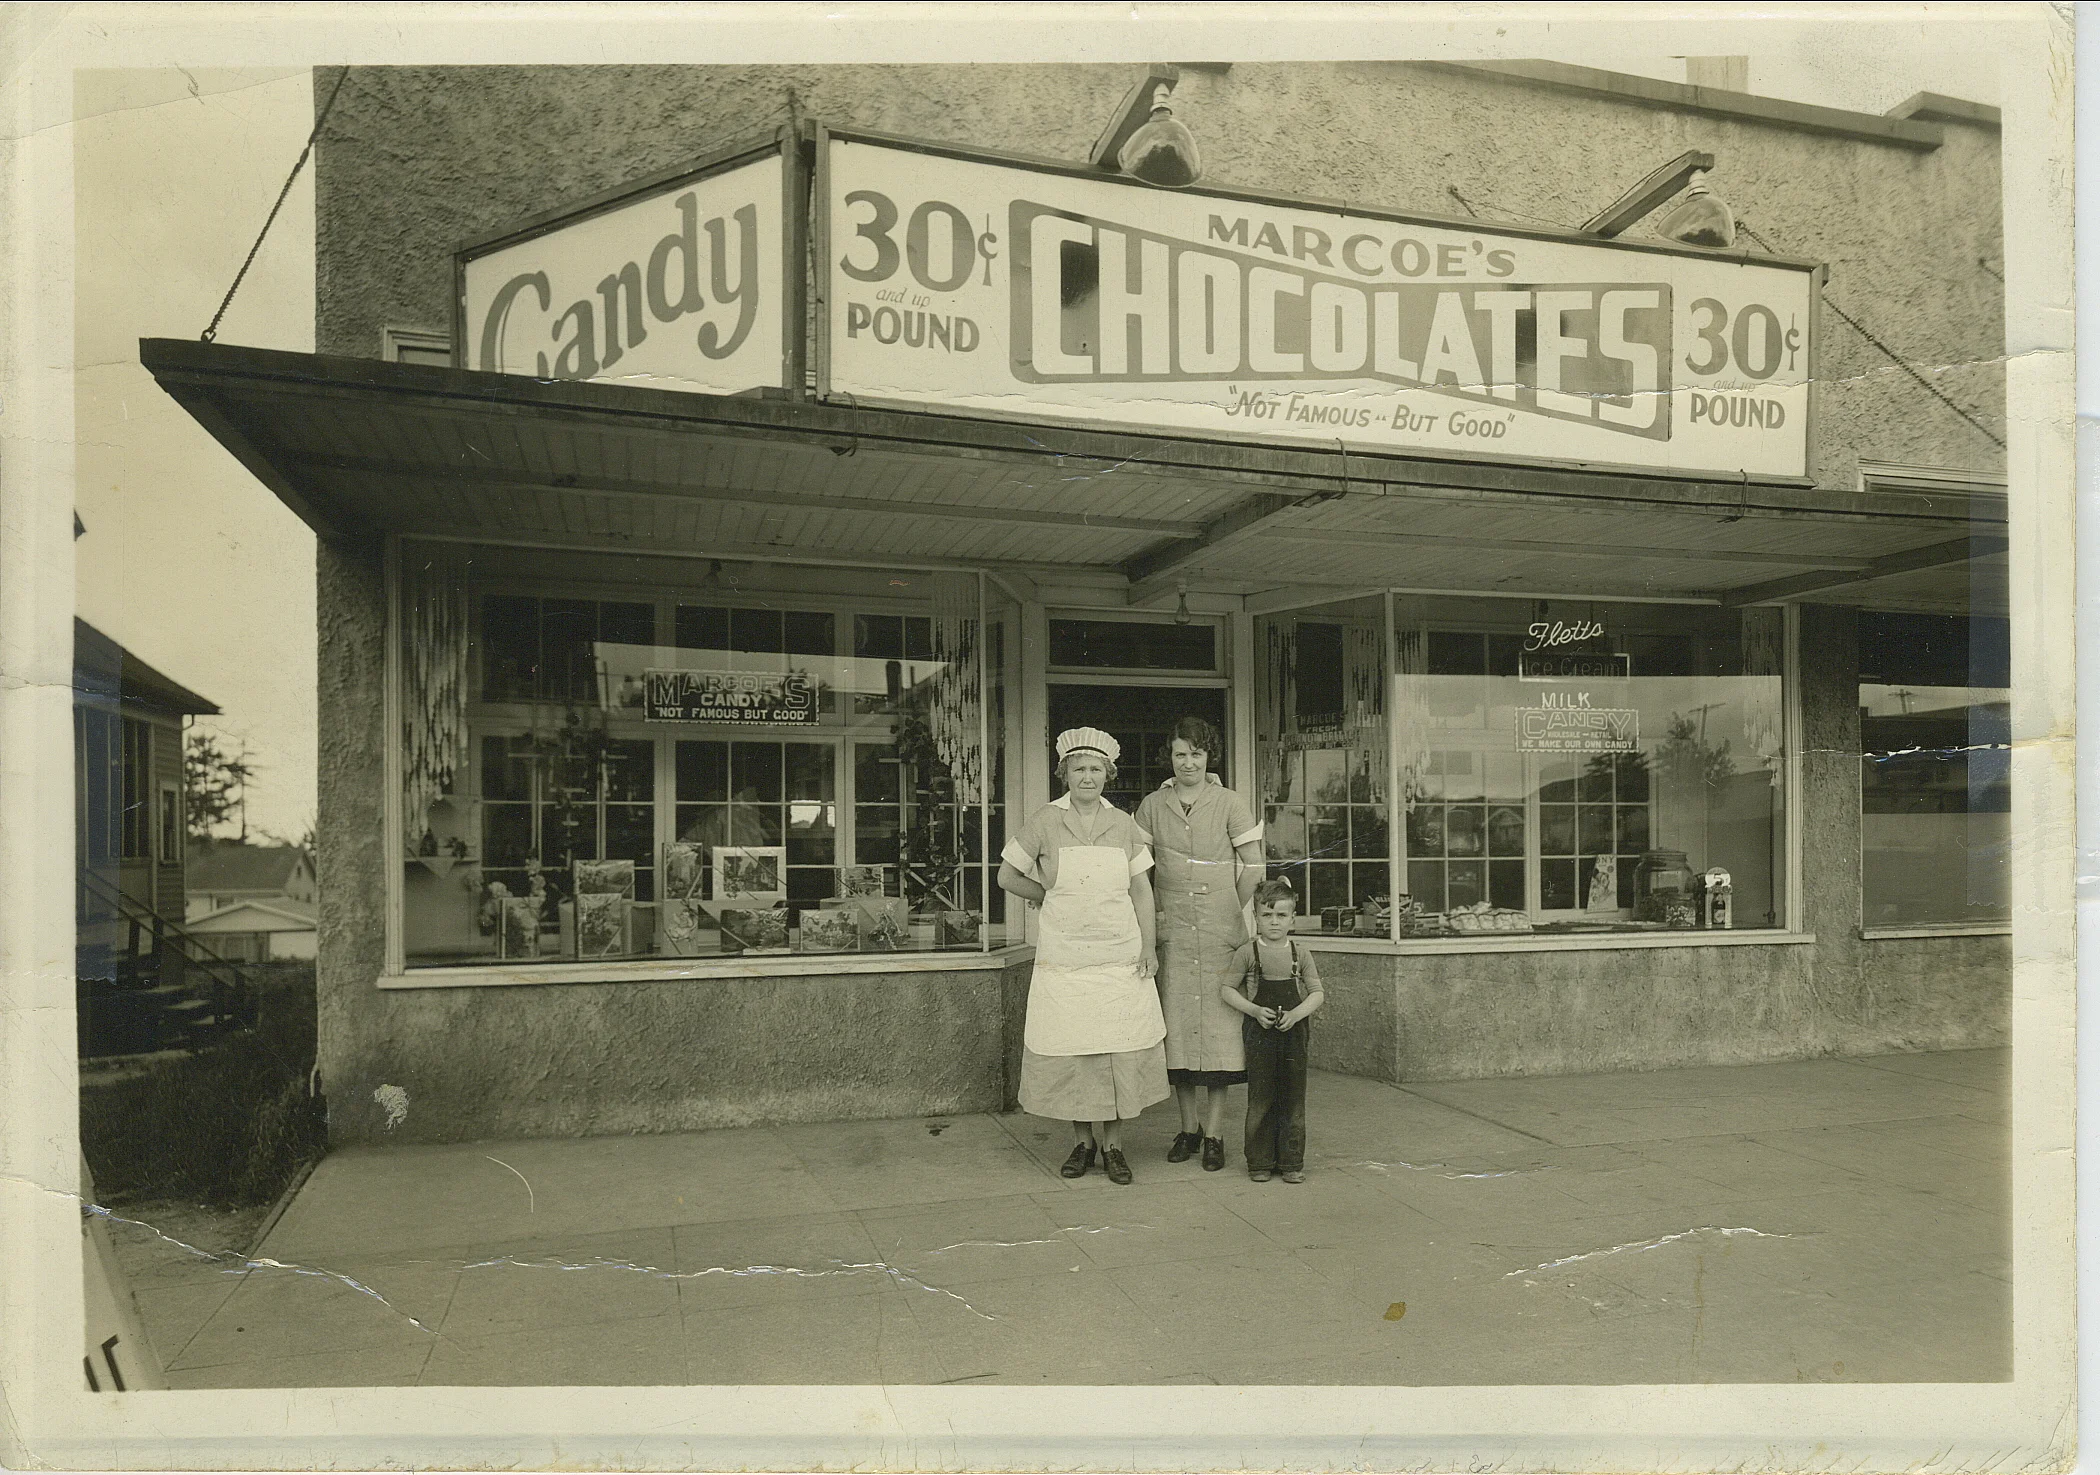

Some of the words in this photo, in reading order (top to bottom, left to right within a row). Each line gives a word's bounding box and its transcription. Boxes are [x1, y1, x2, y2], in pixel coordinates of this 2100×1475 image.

[840, 189, 998, 293] 30¢
[1208, 213, 1516, 279] MARCOE'S
[480, 191, 759, 382] Candy
[875, 285, 906, 305] and
[912, 292, 931, 308] up
[846, 301, 980, 354] POUND
[1029, 213, 1668, 430] CHOCOLATES
[1685, 297, 1801, 380] 30¢
[1285, 394, 1371, 428] FAMOUS
[1391, 404, 1439, 433] BUT
[1448, 411, 1516, 439] GOOD"
[1689, 392, 1786, 431] POUND
[1525, 657, 1553, 677] Ice
[1560, 657, 1621, 677] Cream
[653, 672, 811, 709] MARCOE'S
[701, 693, 763, 707] CANDY
[1541, 692, 1591, 708] MILK
[692, 708, 740, 719] FAMOUS
[744, 709, 768, 720] BUT
[1306, 725, 1337, 734] FRESH
[1522, 710, 1631, 741] CANDY
[1521, 740, 1534, 748] WE
[1538, 740, 1562, 748] MAKE
[1565, 740, 1582, 748] OUR
[1585, 740, 1602, 748] OWN
[1604, 740, 1633, 749] CANDY
